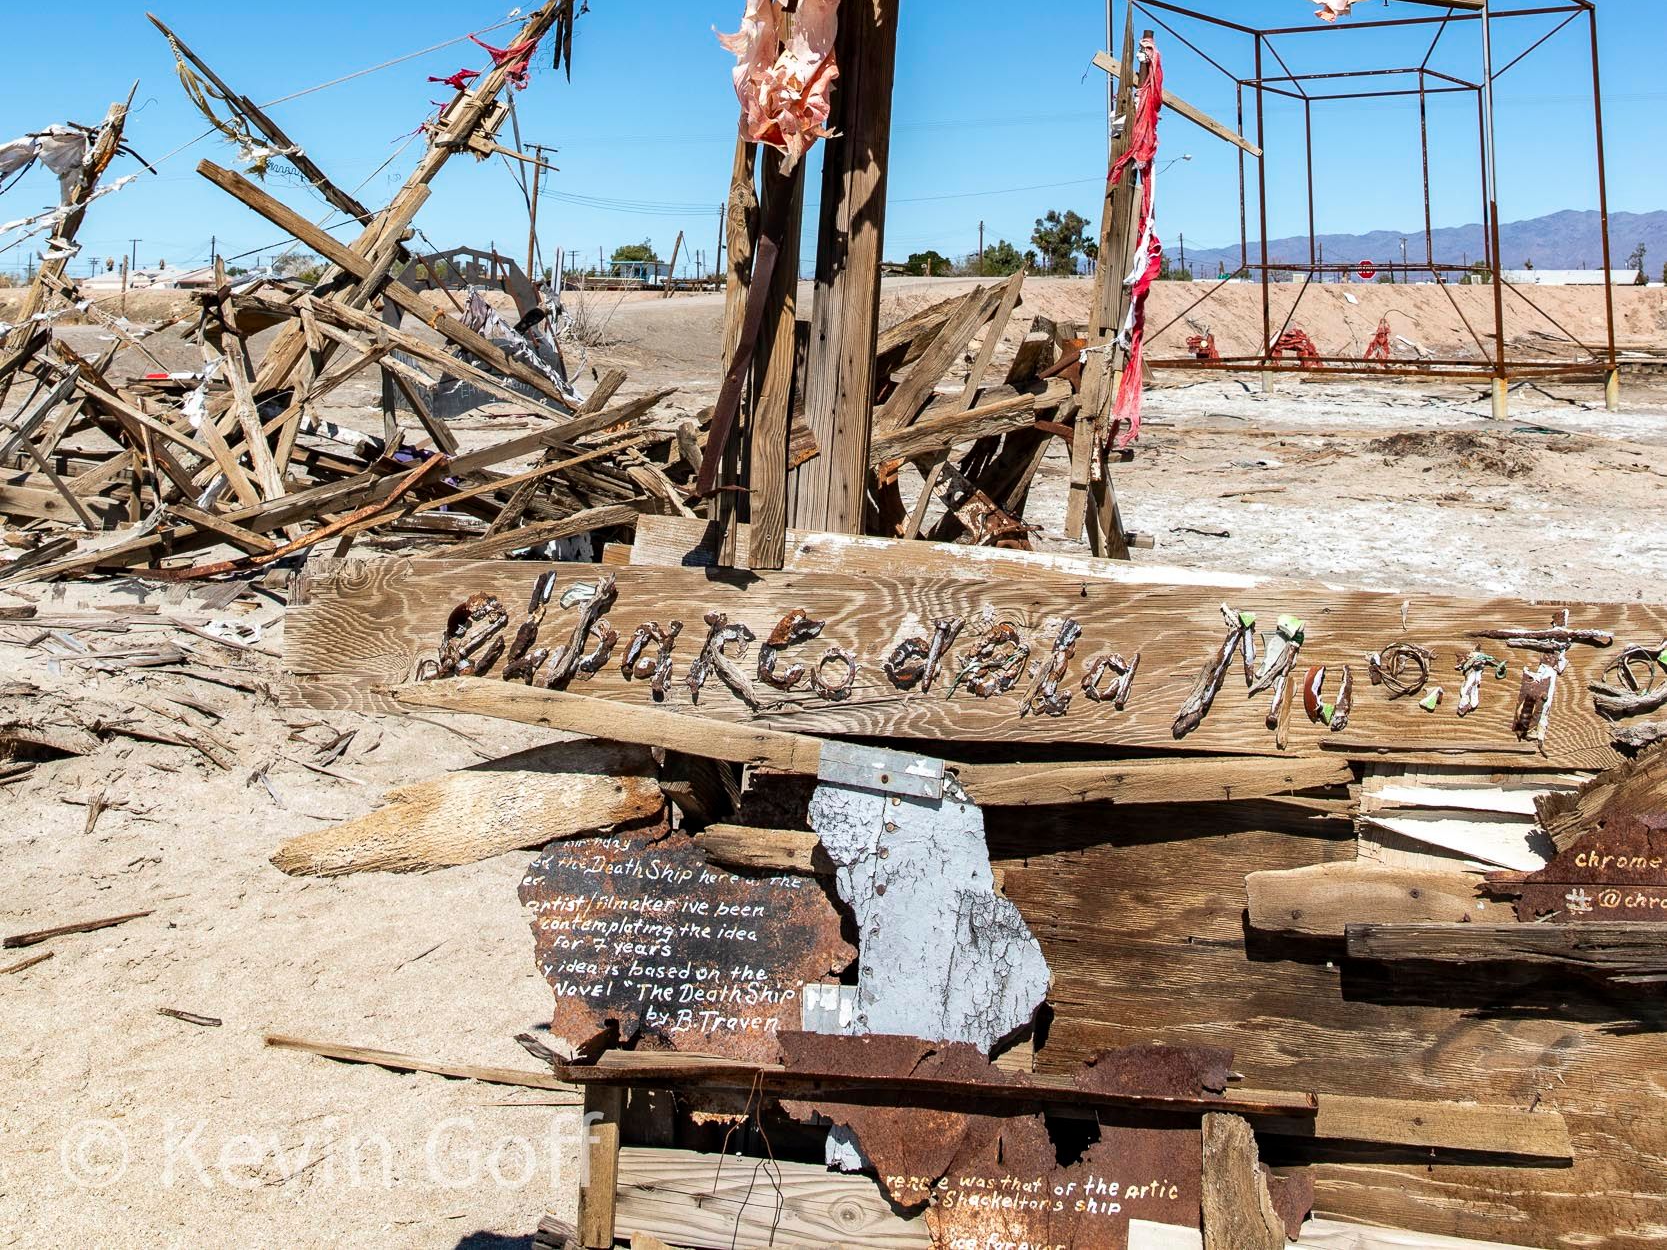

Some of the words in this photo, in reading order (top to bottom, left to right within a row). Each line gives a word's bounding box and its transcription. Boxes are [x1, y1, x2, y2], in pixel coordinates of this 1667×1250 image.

[714, 902, 765, 917] been
[541, 915, 674, 943] contemplating
[680, 923, 711, 939] the
[717, 923, 758, 941] idea
[593, 938, 607, 953] 7
[613, 941, 672, 957] years
[558, 960, 597, 974] idea
[605, 965, 619, 976] is
[628, 960, 692, 980] based
[696, 966, 720, 983] on
[731, 964, 768, 981] the
[646, 1005, 669, 1026] by
[960, 1176, 995, 1190] was
[1000, 1174, 1042, 1193] that
[1083, 1174, 1120, 1197] the
[1075, 1197, 1121, 1215] ship
